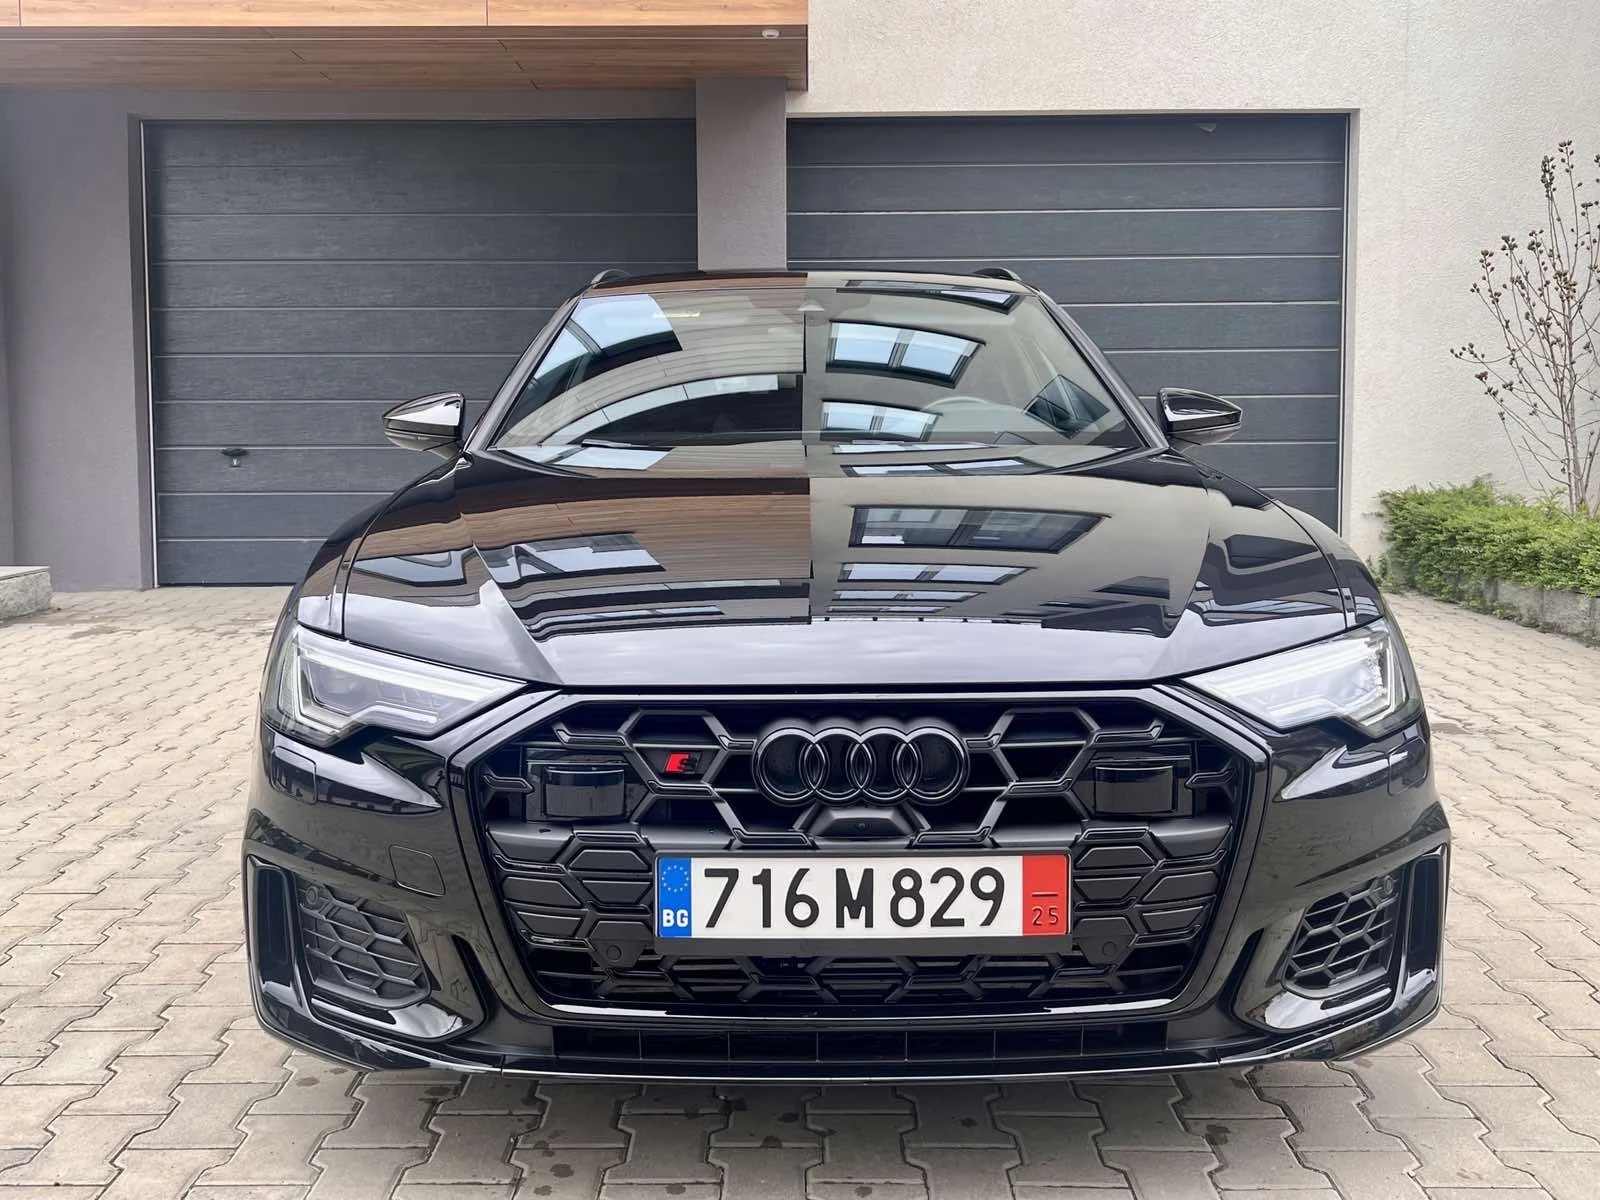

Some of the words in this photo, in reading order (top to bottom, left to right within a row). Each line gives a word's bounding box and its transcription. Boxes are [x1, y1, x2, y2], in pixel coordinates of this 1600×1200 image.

[704, 868, 819, 928] 716
[835, 868, 874, 928] M
[890, 866, 1005, 927] 829
[662, 908, 689, 928] BG
[1031, 905, 1059, 926] 25
